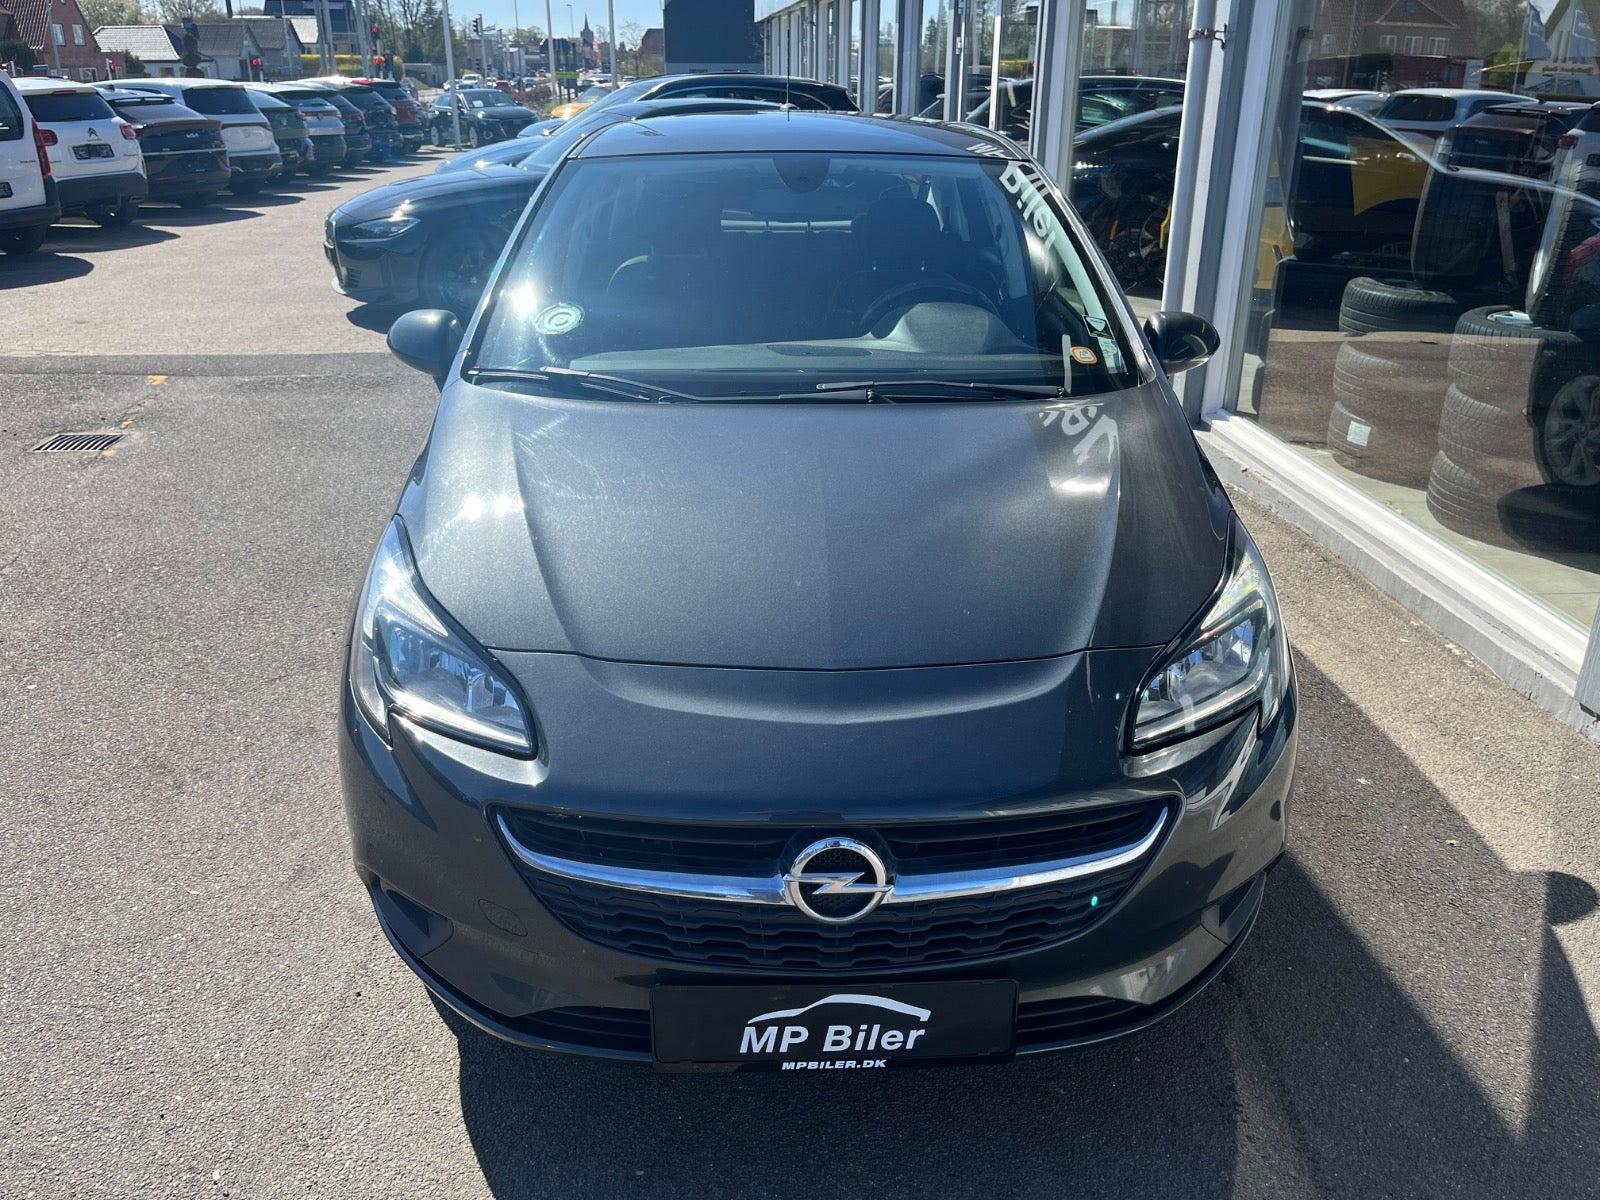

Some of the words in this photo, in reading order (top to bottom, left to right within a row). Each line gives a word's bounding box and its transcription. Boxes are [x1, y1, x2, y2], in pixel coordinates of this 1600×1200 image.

[740, 1025, 809, 1053] MP
[823, 1024, 925, 1052] Biler
[781, 1059, 887, 1070] MPBILER.DK
